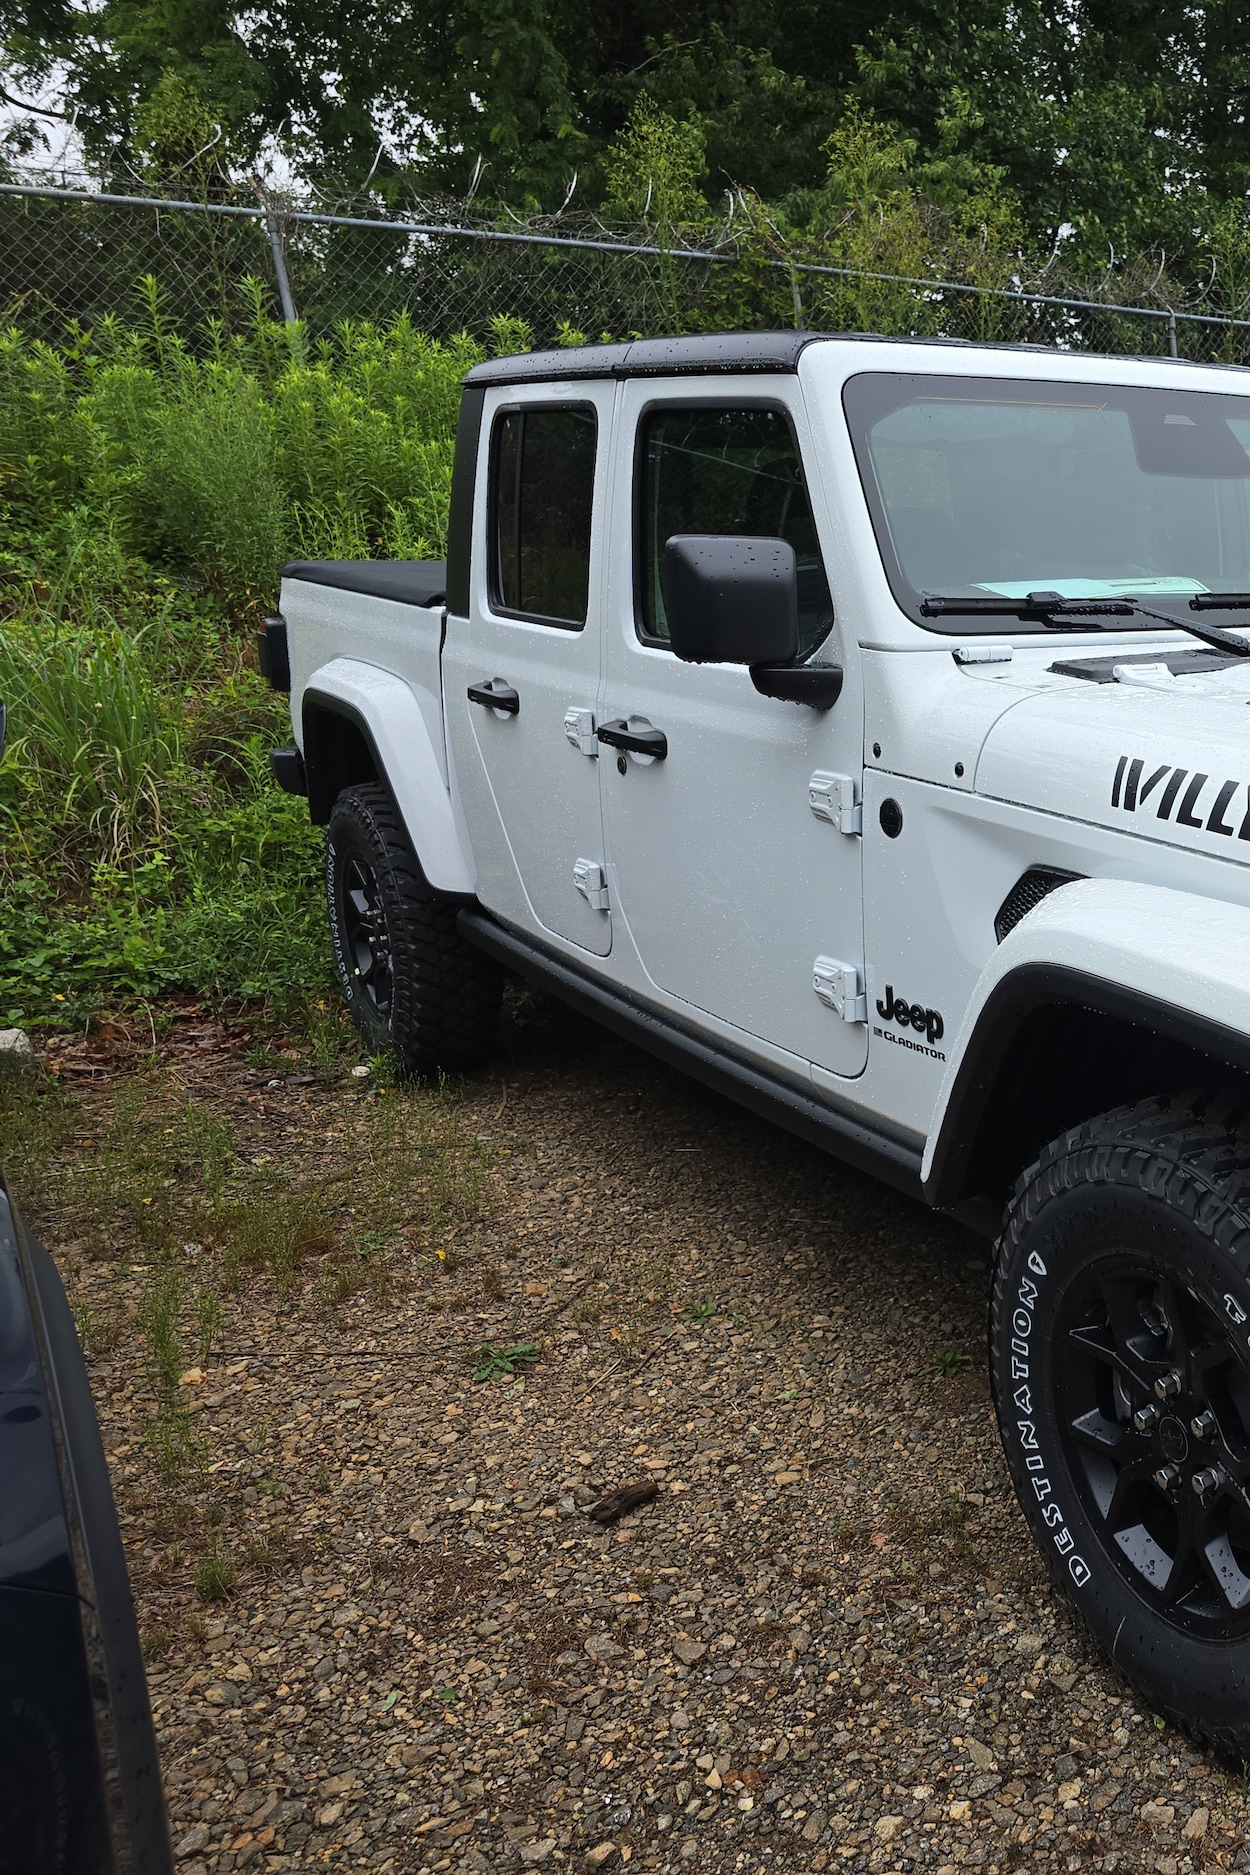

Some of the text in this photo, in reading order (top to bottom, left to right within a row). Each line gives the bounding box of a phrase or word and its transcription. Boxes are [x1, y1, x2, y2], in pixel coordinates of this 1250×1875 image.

[875, 983, 945, 1045] Jeep
[883, 1030, 947, 1063] GLADIATOR
[1011, 1276, 1092, 1588] DESTINATION
